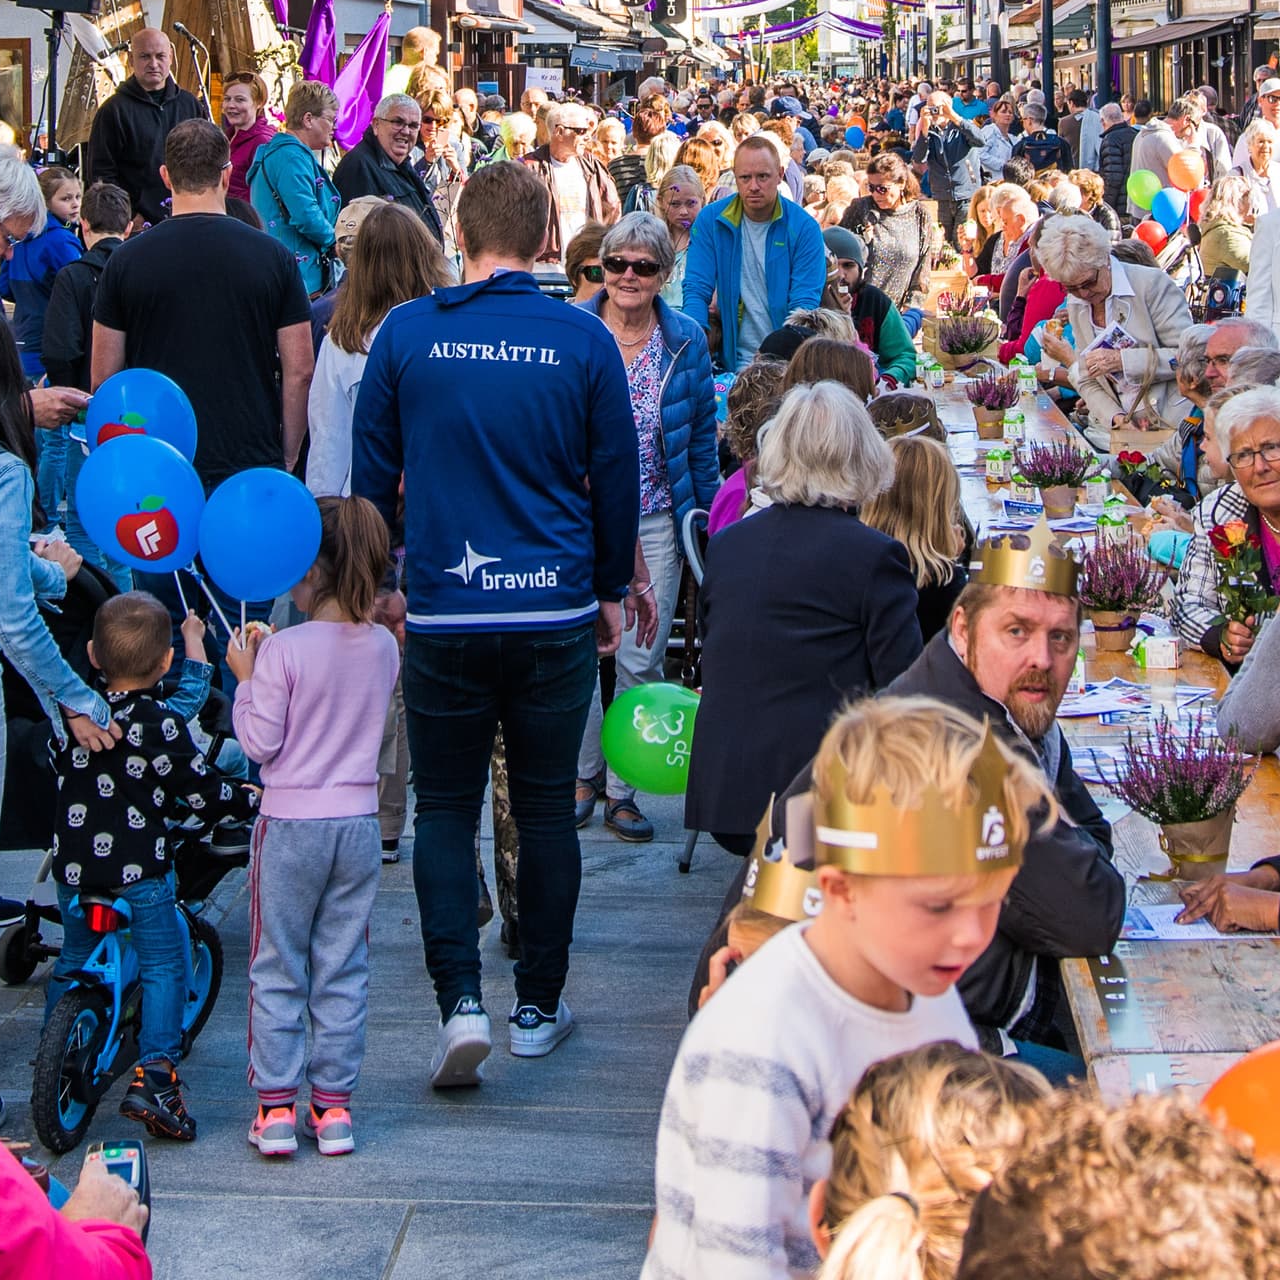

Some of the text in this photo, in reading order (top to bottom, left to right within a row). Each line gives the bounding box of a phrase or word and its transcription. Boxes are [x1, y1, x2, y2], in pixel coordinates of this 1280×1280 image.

[428, 340, 561, 365] AUSTRÅTT IL
[481, 566, 558, 591] bravida
